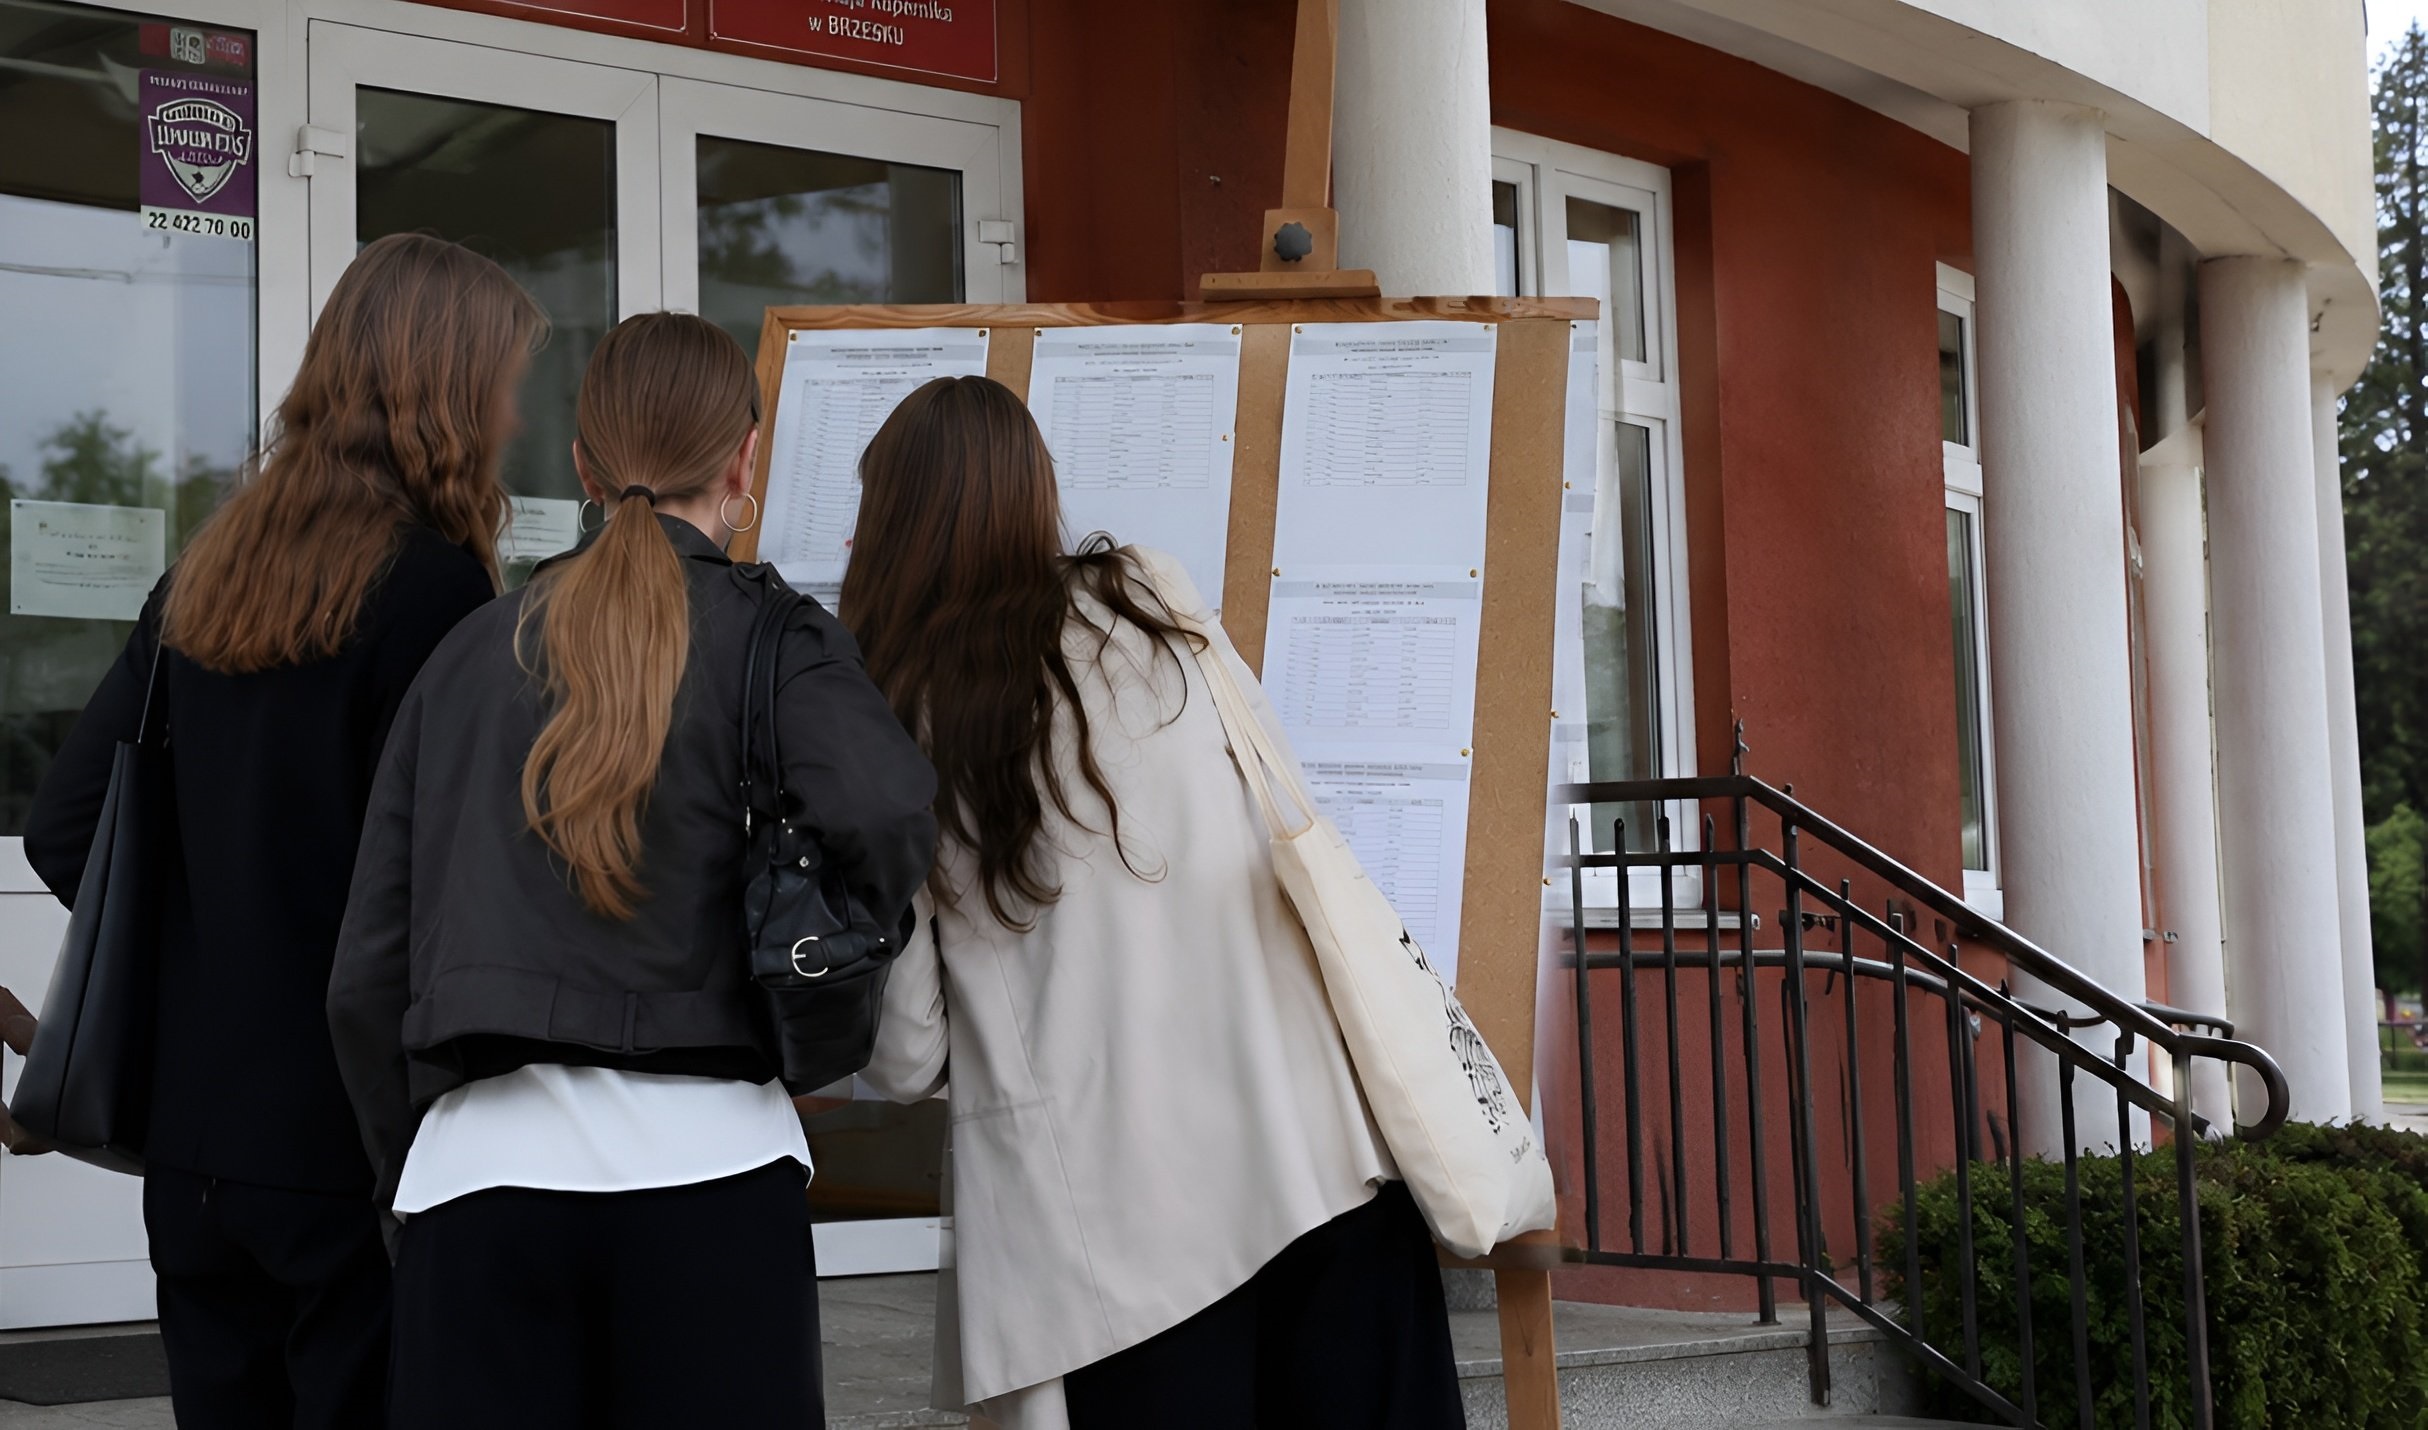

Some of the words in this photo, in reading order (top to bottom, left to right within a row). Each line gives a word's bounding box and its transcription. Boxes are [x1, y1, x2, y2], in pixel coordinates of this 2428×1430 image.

[808, 16, 822, 32] w
[828, 15, 904, 46] BRZESKU
[149, 211, 168, 230] 22
[204, 217, 224, 235] 70
[230, 220, 251, 239] 00
